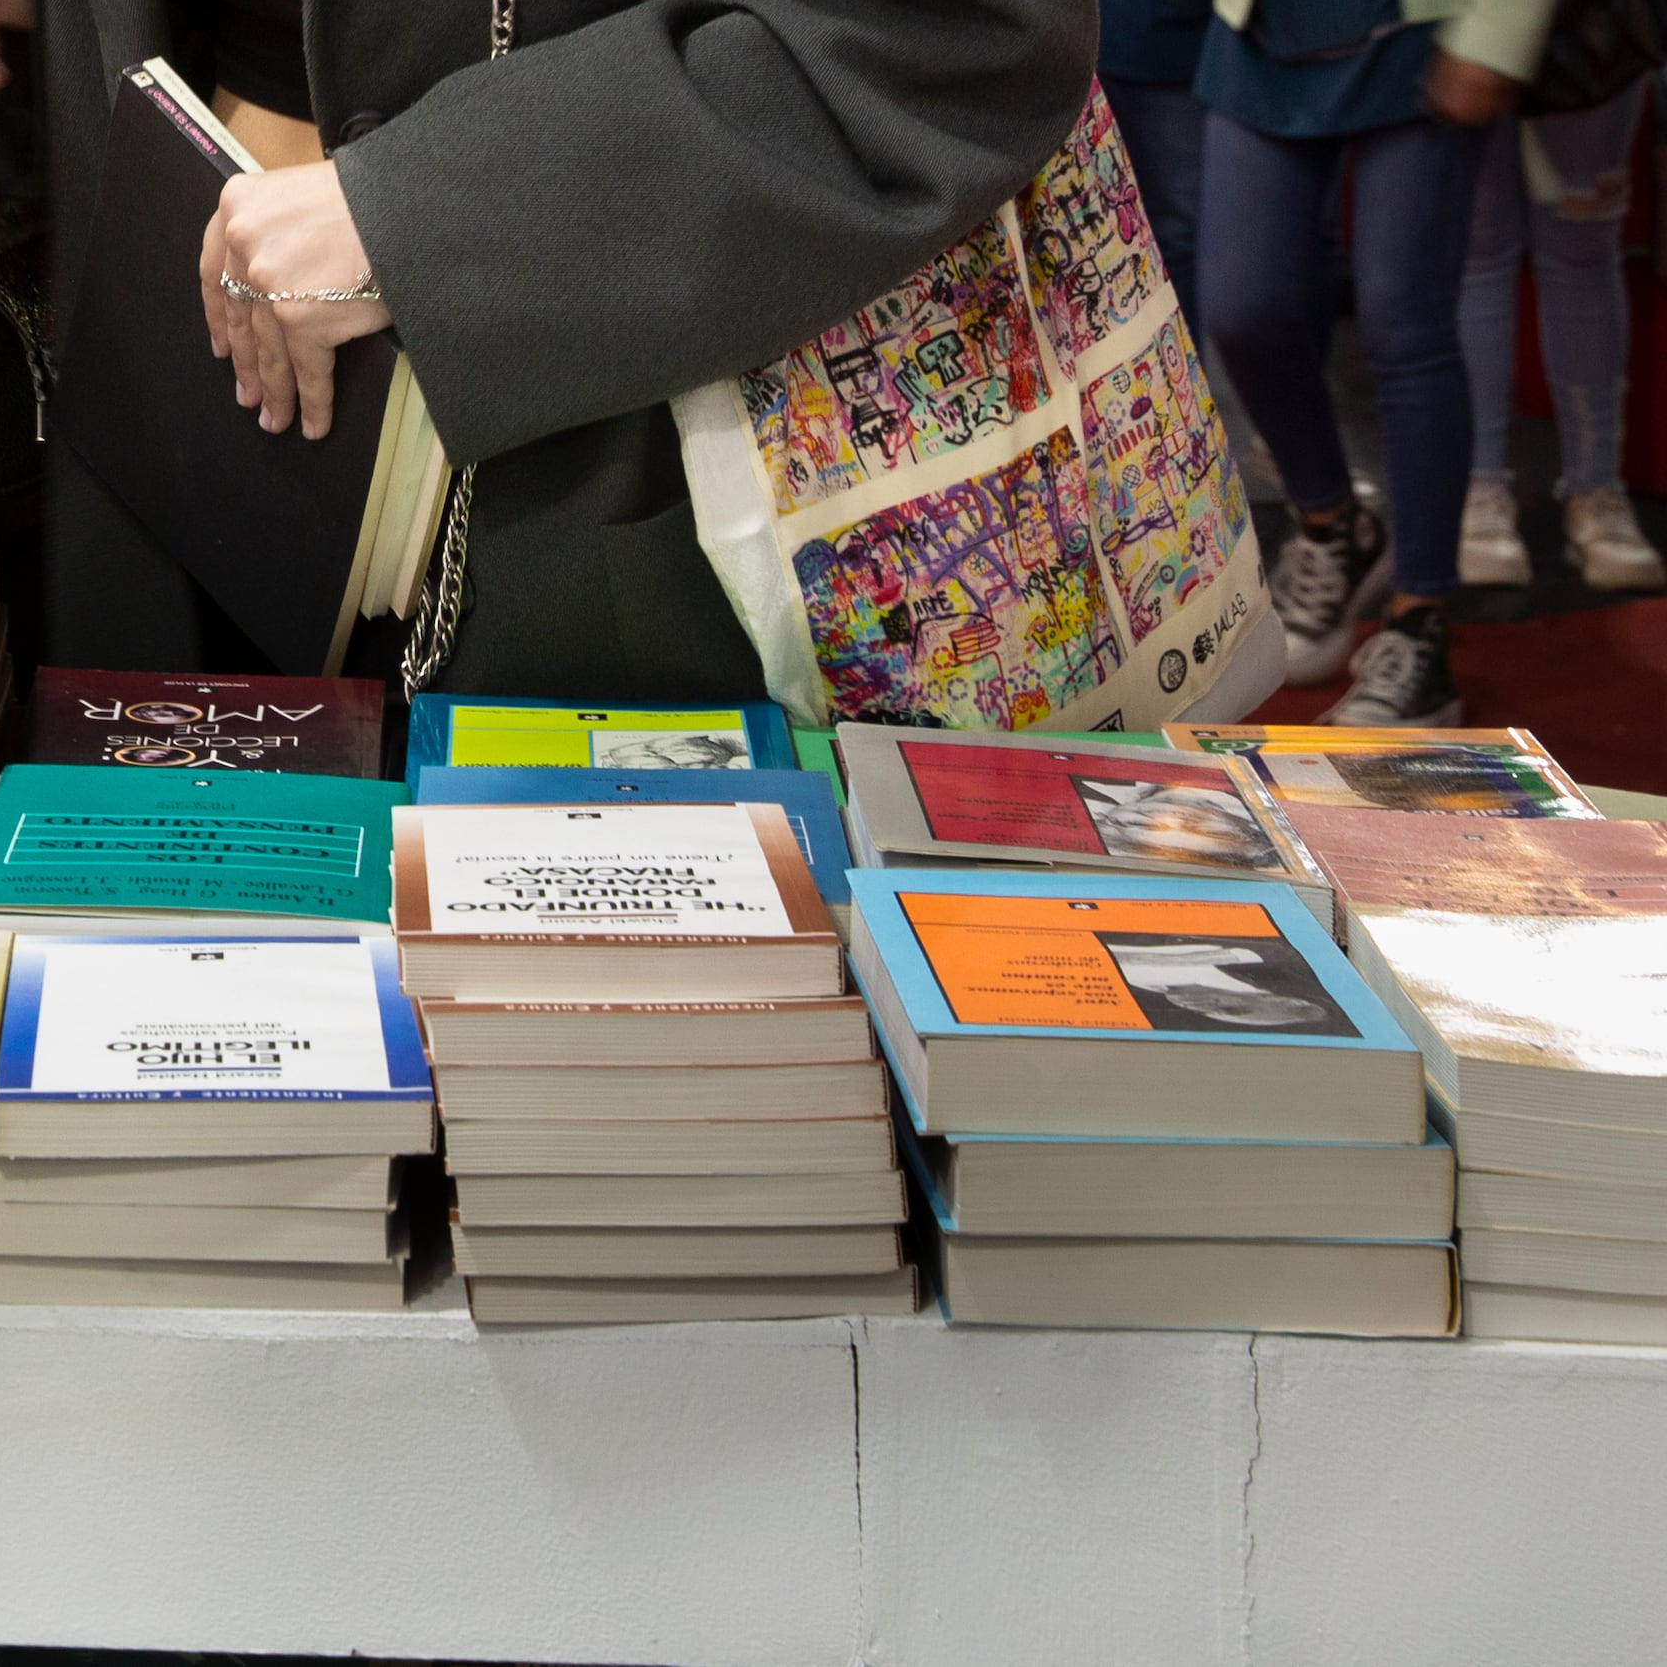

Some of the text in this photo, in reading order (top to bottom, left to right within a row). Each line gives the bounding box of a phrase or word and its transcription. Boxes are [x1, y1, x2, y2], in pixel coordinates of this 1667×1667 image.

[173, 724, 220, 734] DE
[106, 735, 299, 747] LECCIONES
[43, 816, 336, 834] PENSAMIENTO
[164, 830, 217, 840] DE
[36, 839, 330, 858] CONTINENTES
[144, 854, 223, 864] LOS
[483, 877, 717, 886] PARANOICO
[501, 887, 703, 898] DONDE EL
[446, 900, 682, 912] TRIUNFADO
[136, 1053, 282, 1064] EL HIJO
